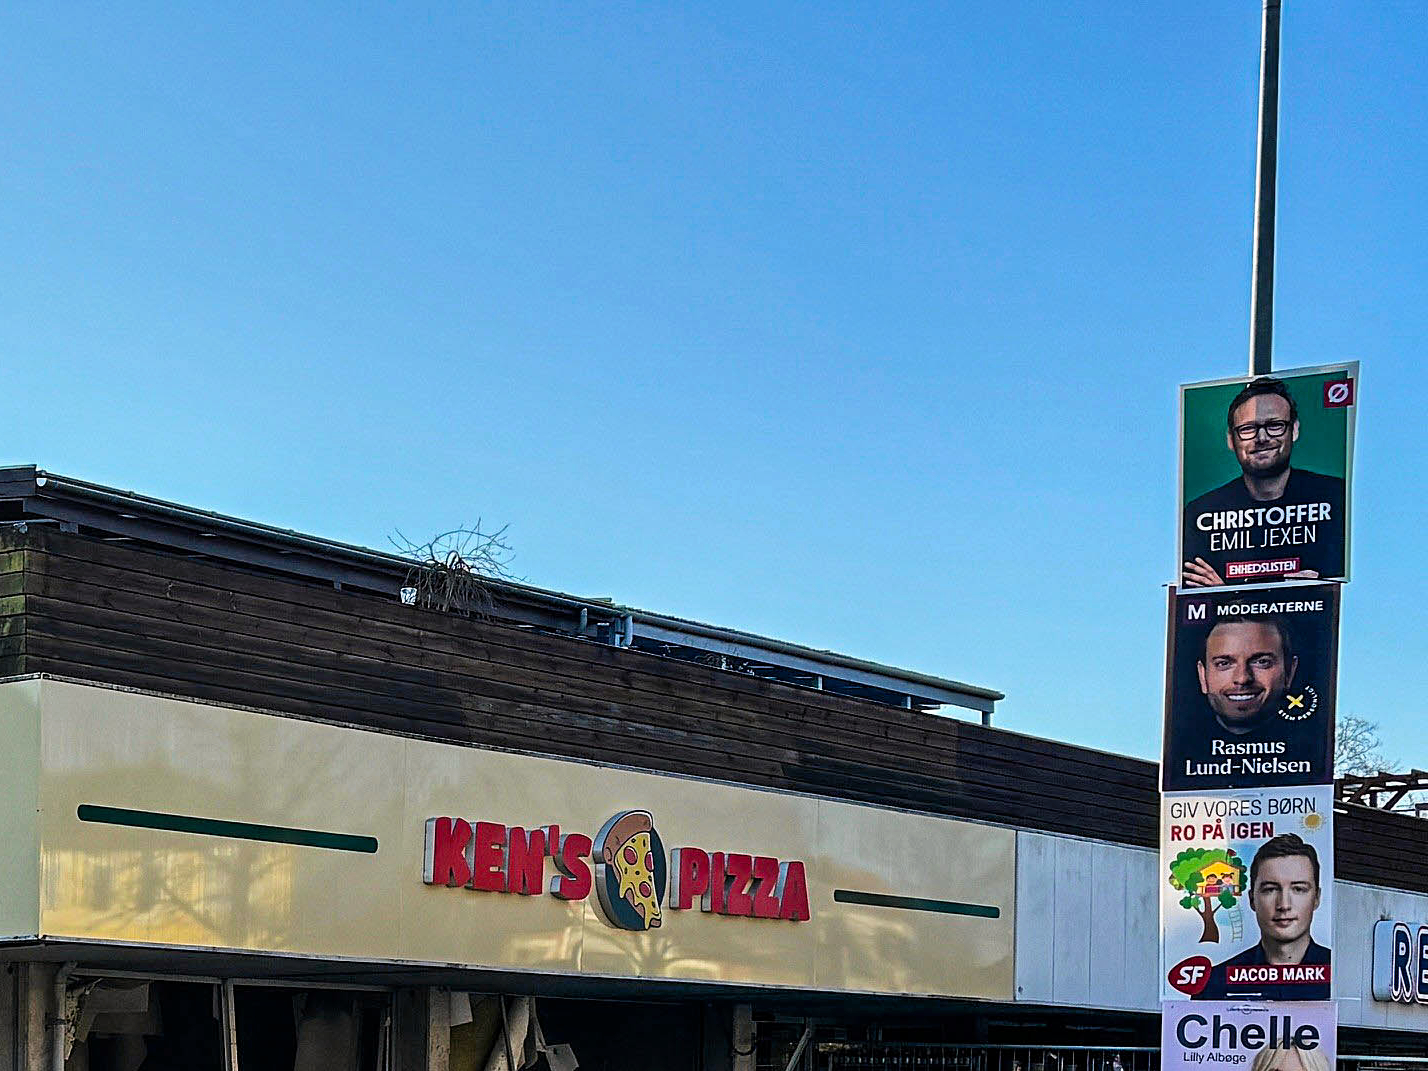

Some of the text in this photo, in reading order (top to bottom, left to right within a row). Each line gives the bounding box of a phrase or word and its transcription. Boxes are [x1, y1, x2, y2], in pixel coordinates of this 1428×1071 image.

[1196, 502, 1332, 531] CHRISTOFFER
[1210, 524, 1316, 551] EMIL JEXEN
[1228, 559, 1297, 576] ENHEDSLISTEN
[1187, 600, 1324, 620] M MODERATERNE
[1211, 738, 1286, 756] Rasmus
[1185, 757, 1312, 776] Lund-Nielsen
[1170, 797, 1316, 819] GIV VORES BØRN
[1171, 818, 1275, 841] RO PÅ IGEN
[424, 815, 812, 922] KEN'S PIZZA
[1176, 965, 1206, 985] SF
[1229, 966, 1326, 983] JACOB MARK
[1176, 1013, 1321, 1051] Chelle
[1183, 1052, 1247, 1065] Lilly Albøge
